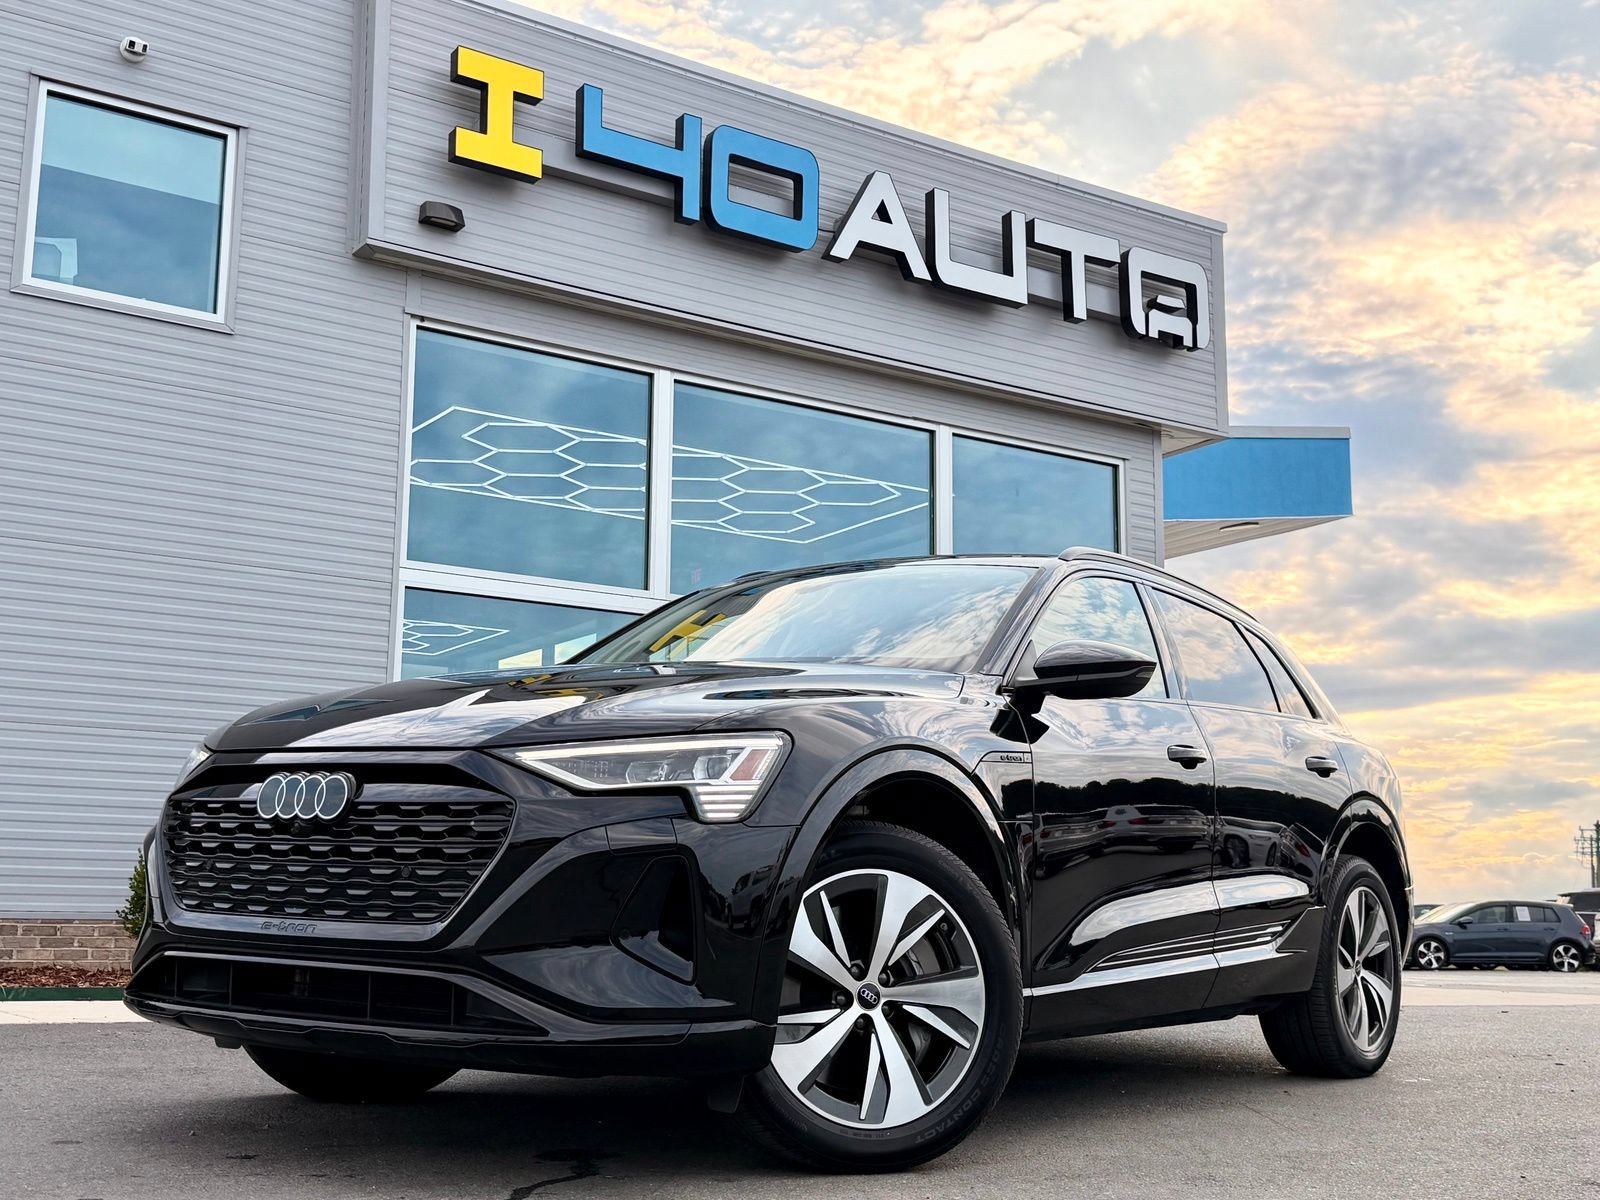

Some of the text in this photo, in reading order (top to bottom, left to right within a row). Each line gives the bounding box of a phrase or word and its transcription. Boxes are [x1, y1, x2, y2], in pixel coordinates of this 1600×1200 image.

[449, 45, 544, 183] I
[576, 83, 820, 252] 40
[260, 921, 318, 934] e-tron
[914, 1087, 982, 1145] CONTACT
